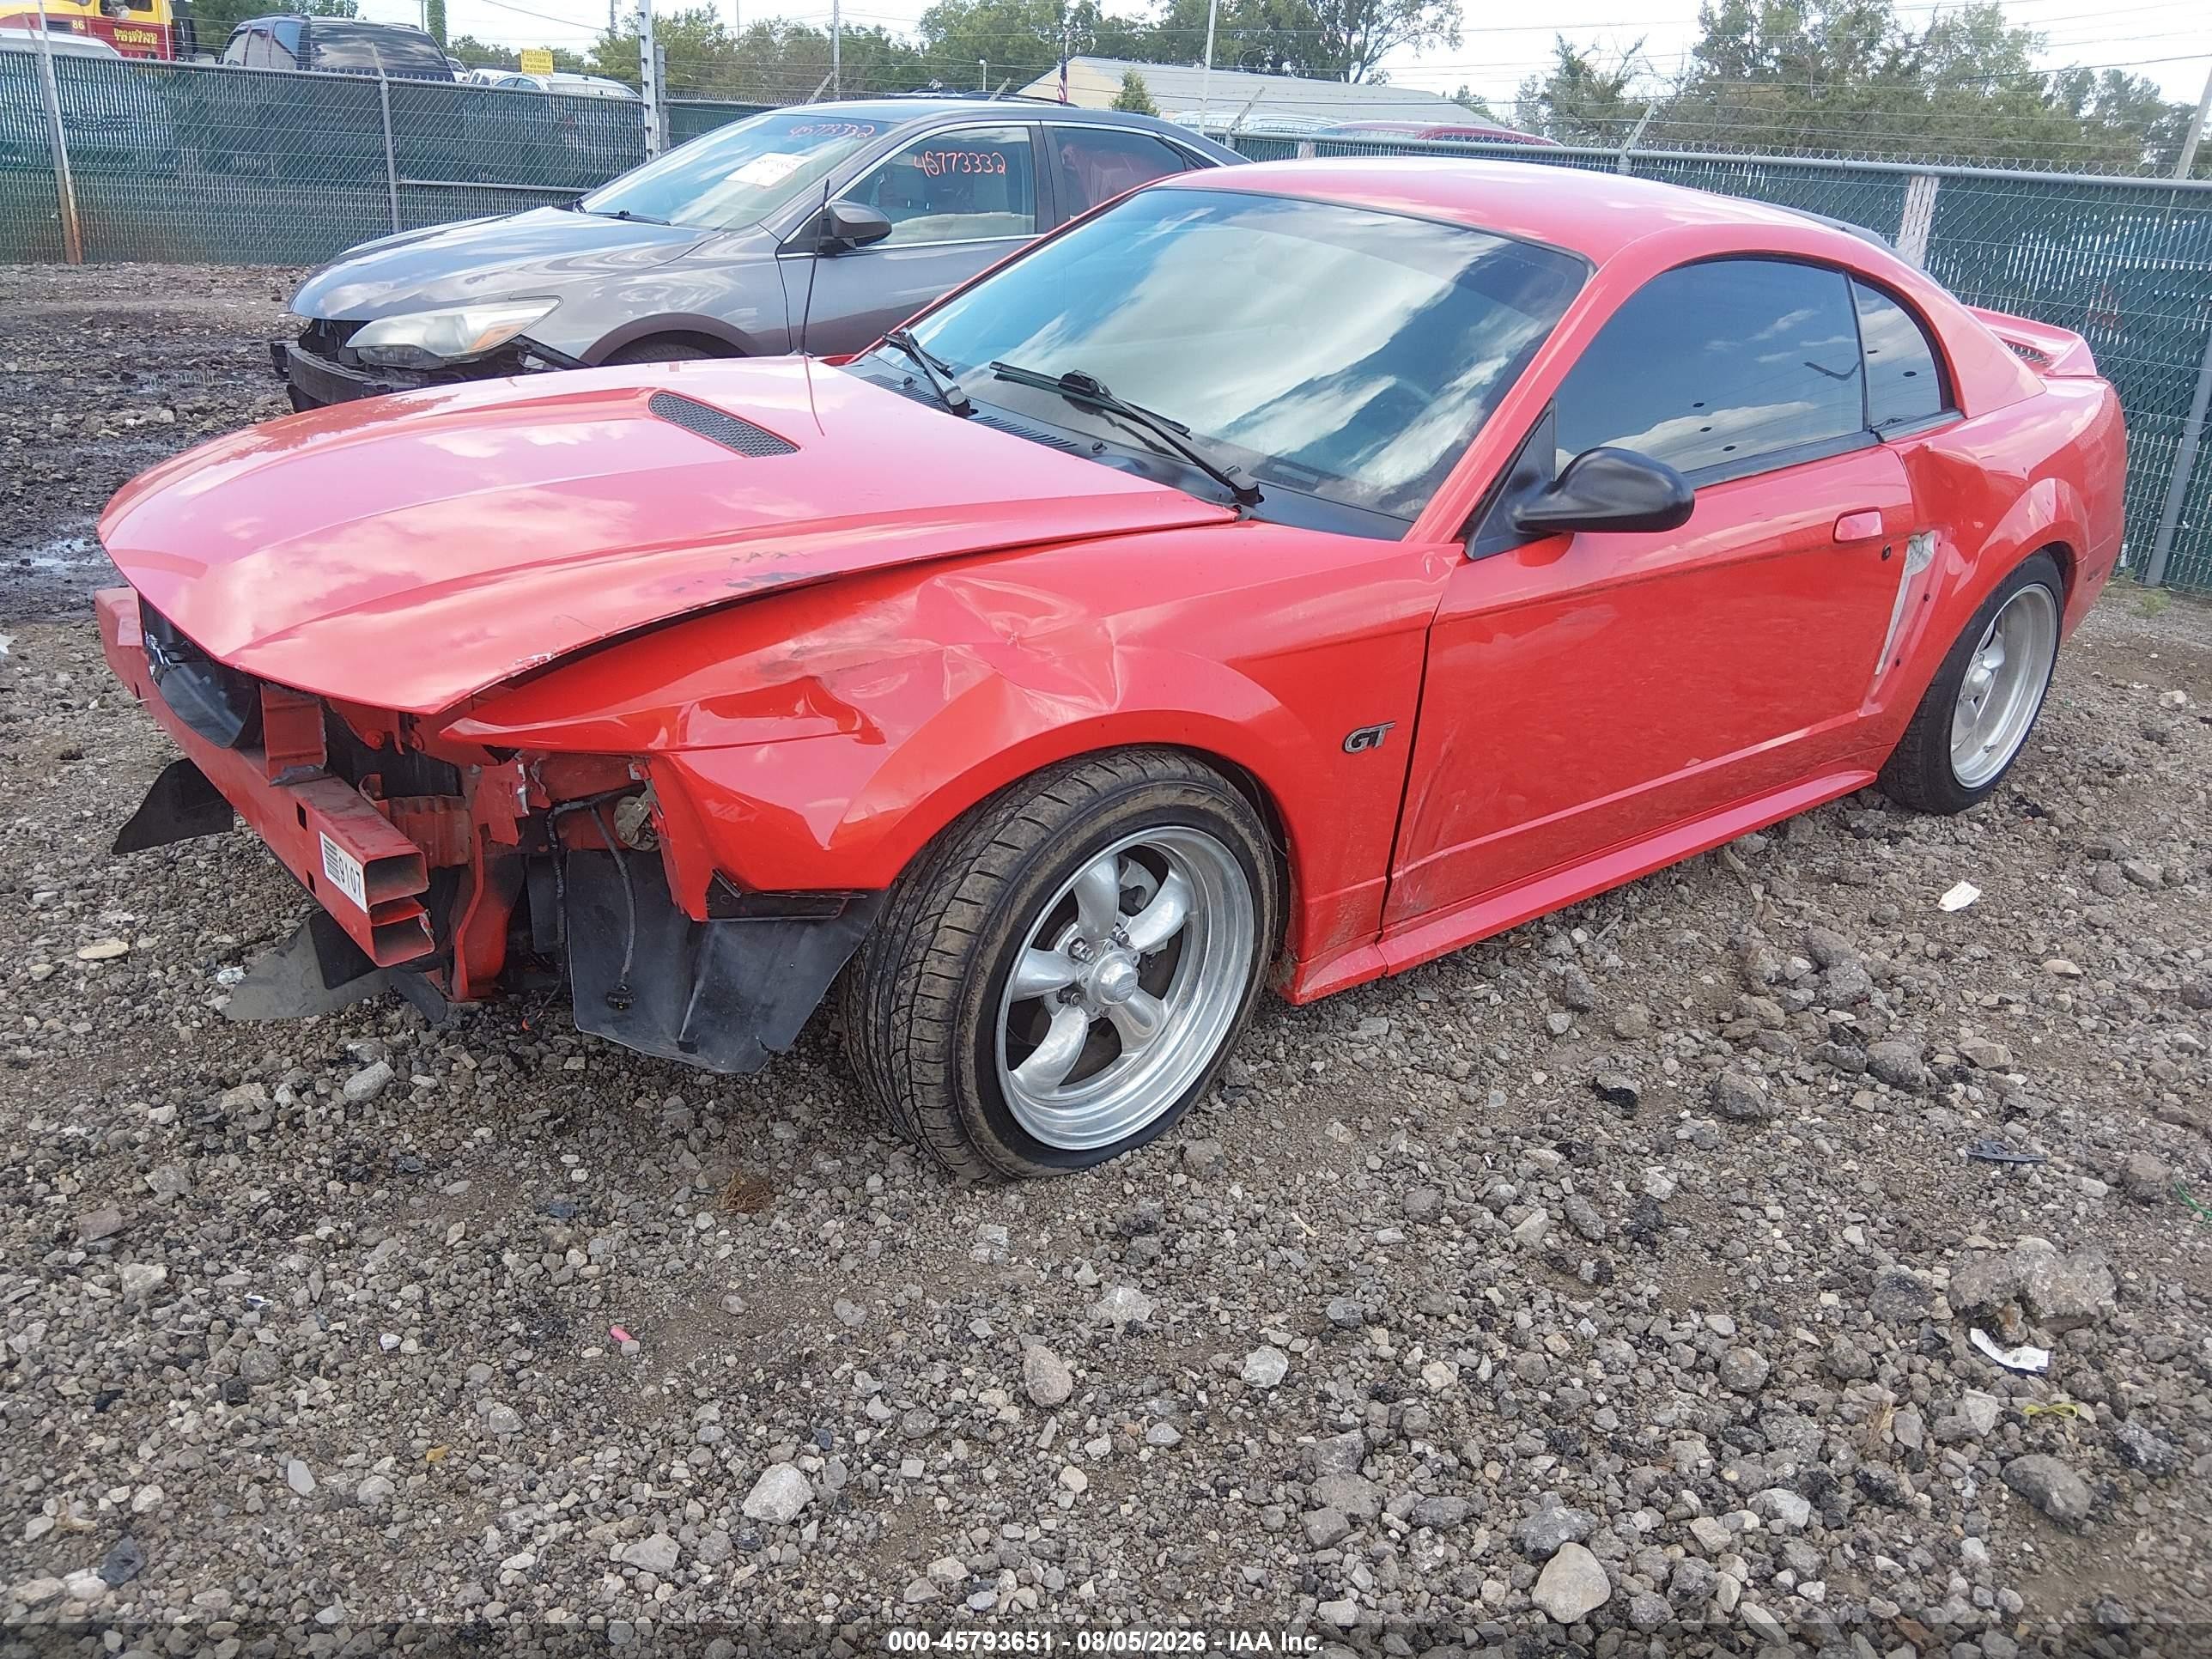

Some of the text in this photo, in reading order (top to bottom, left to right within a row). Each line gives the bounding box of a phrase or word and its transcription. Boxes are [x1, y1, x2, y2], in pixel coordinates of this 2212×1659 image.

[72, 20, 85, 29] 86
[115, 33, 158, 44] TOWING
[1342, 720, 1396, 753] GT
[339, 856, 362, 898] 9107
